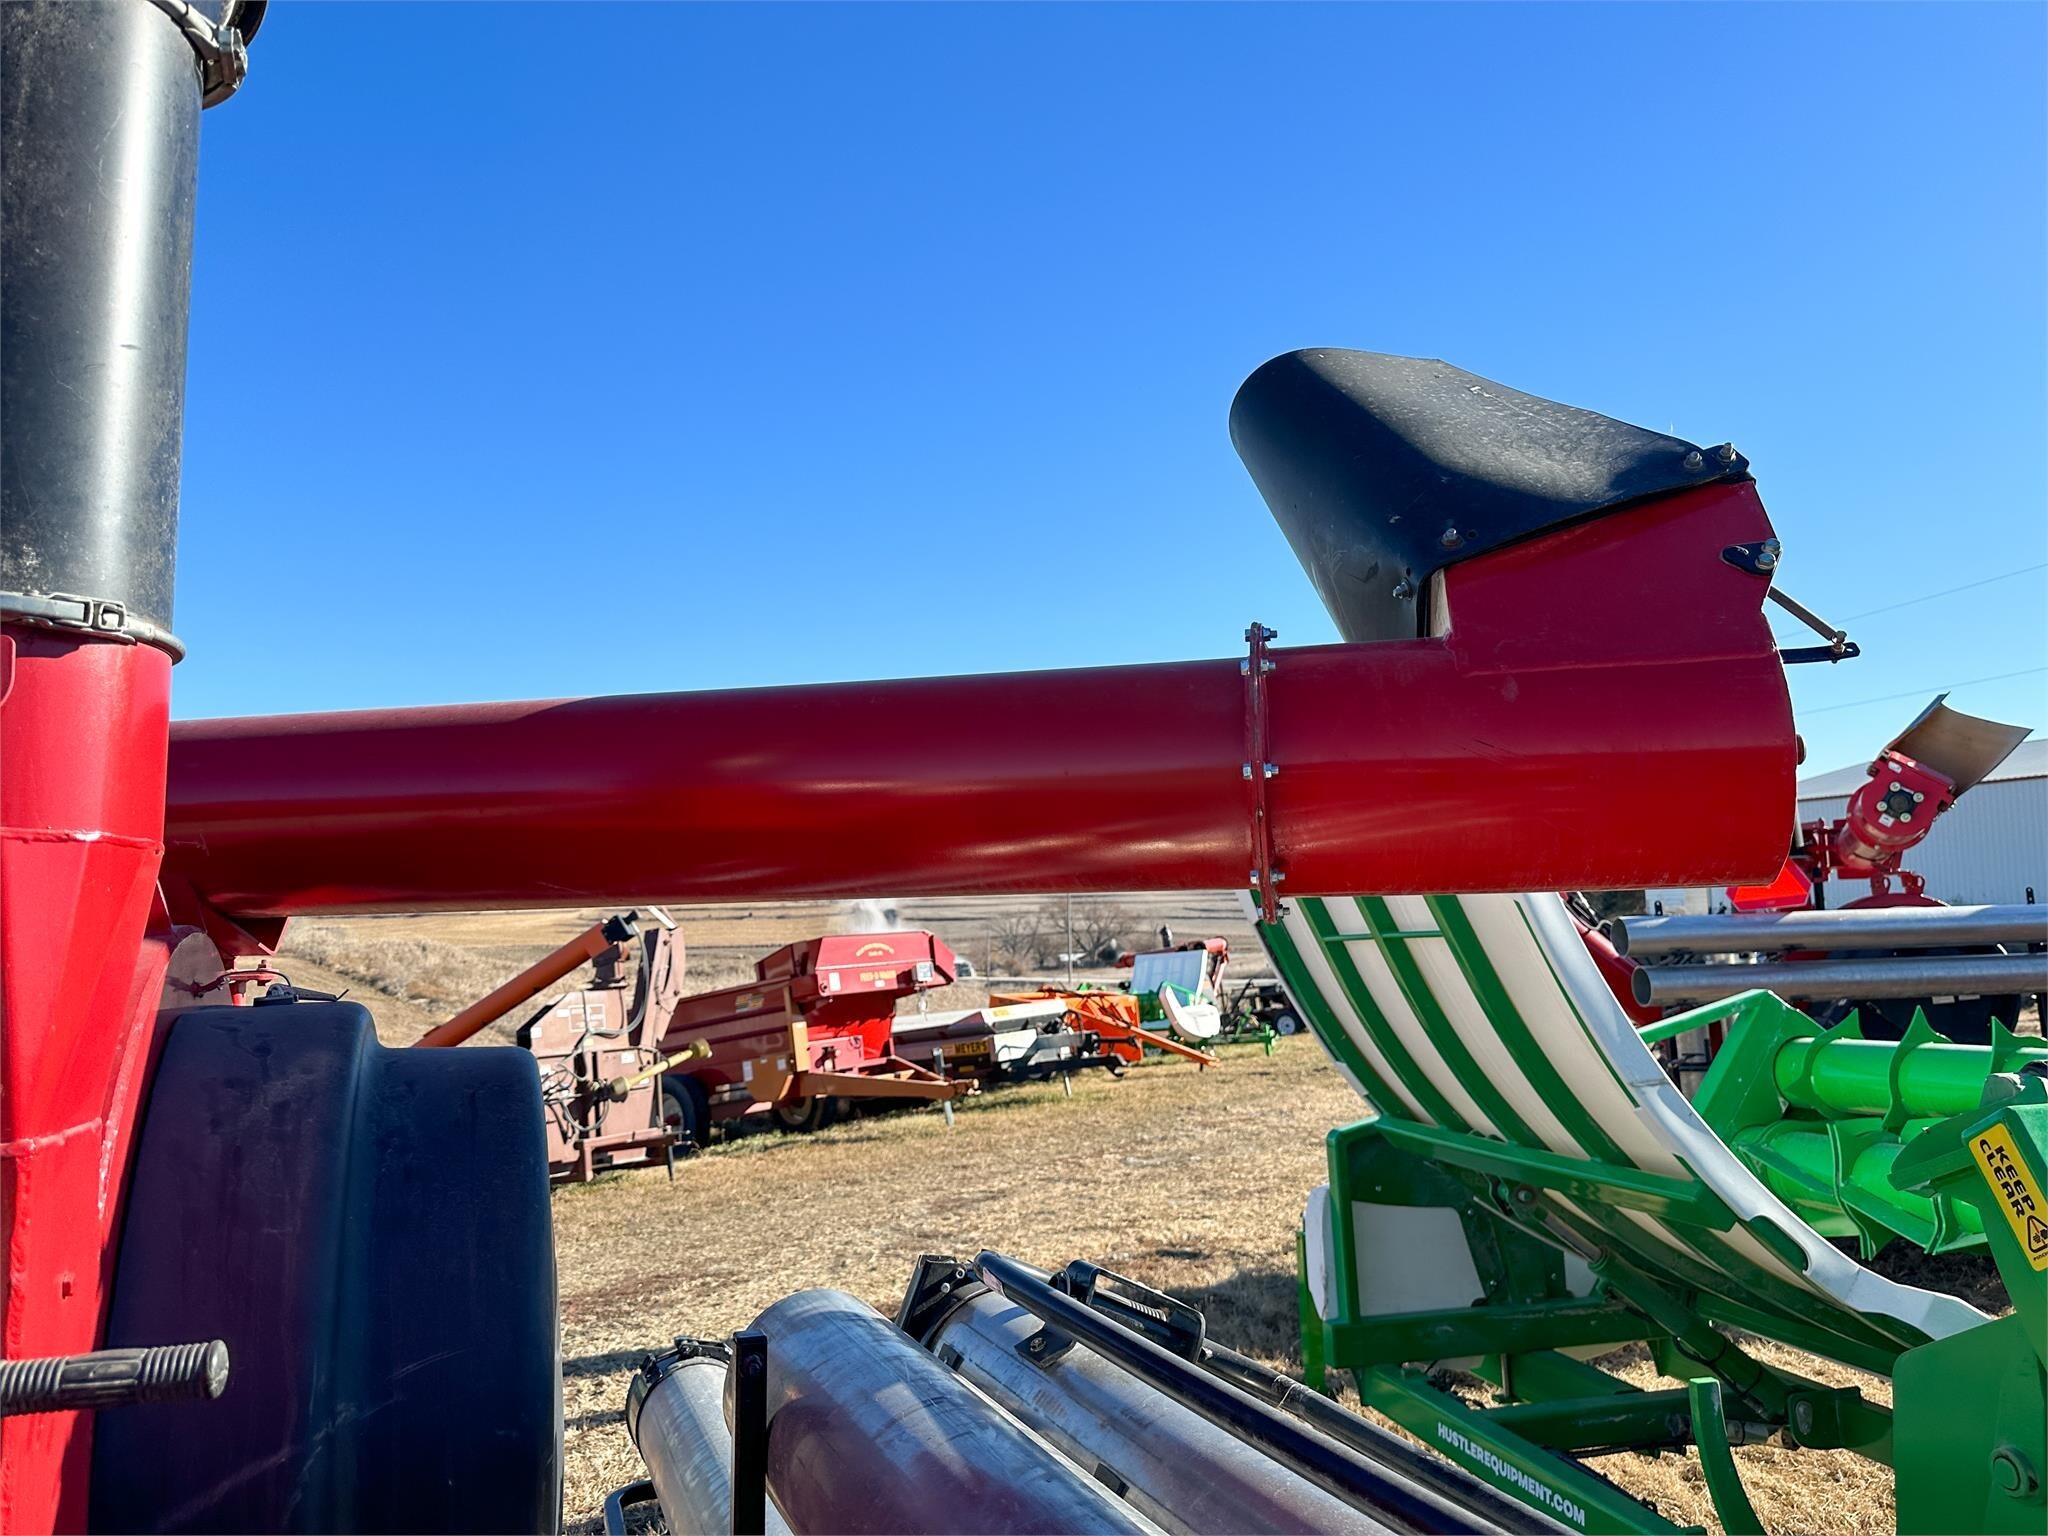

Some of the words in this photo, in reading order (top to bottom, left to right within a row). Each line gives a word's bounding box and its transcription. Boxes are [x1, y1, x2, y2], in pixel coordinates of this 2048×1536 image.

[1979, 1138, 2025, 1218] CLEAR
[1994, 1145, 2036, 1212] KEEP
[1437, 1421, 1585, 1527] HUSTLEREQUIPMENT.COM
